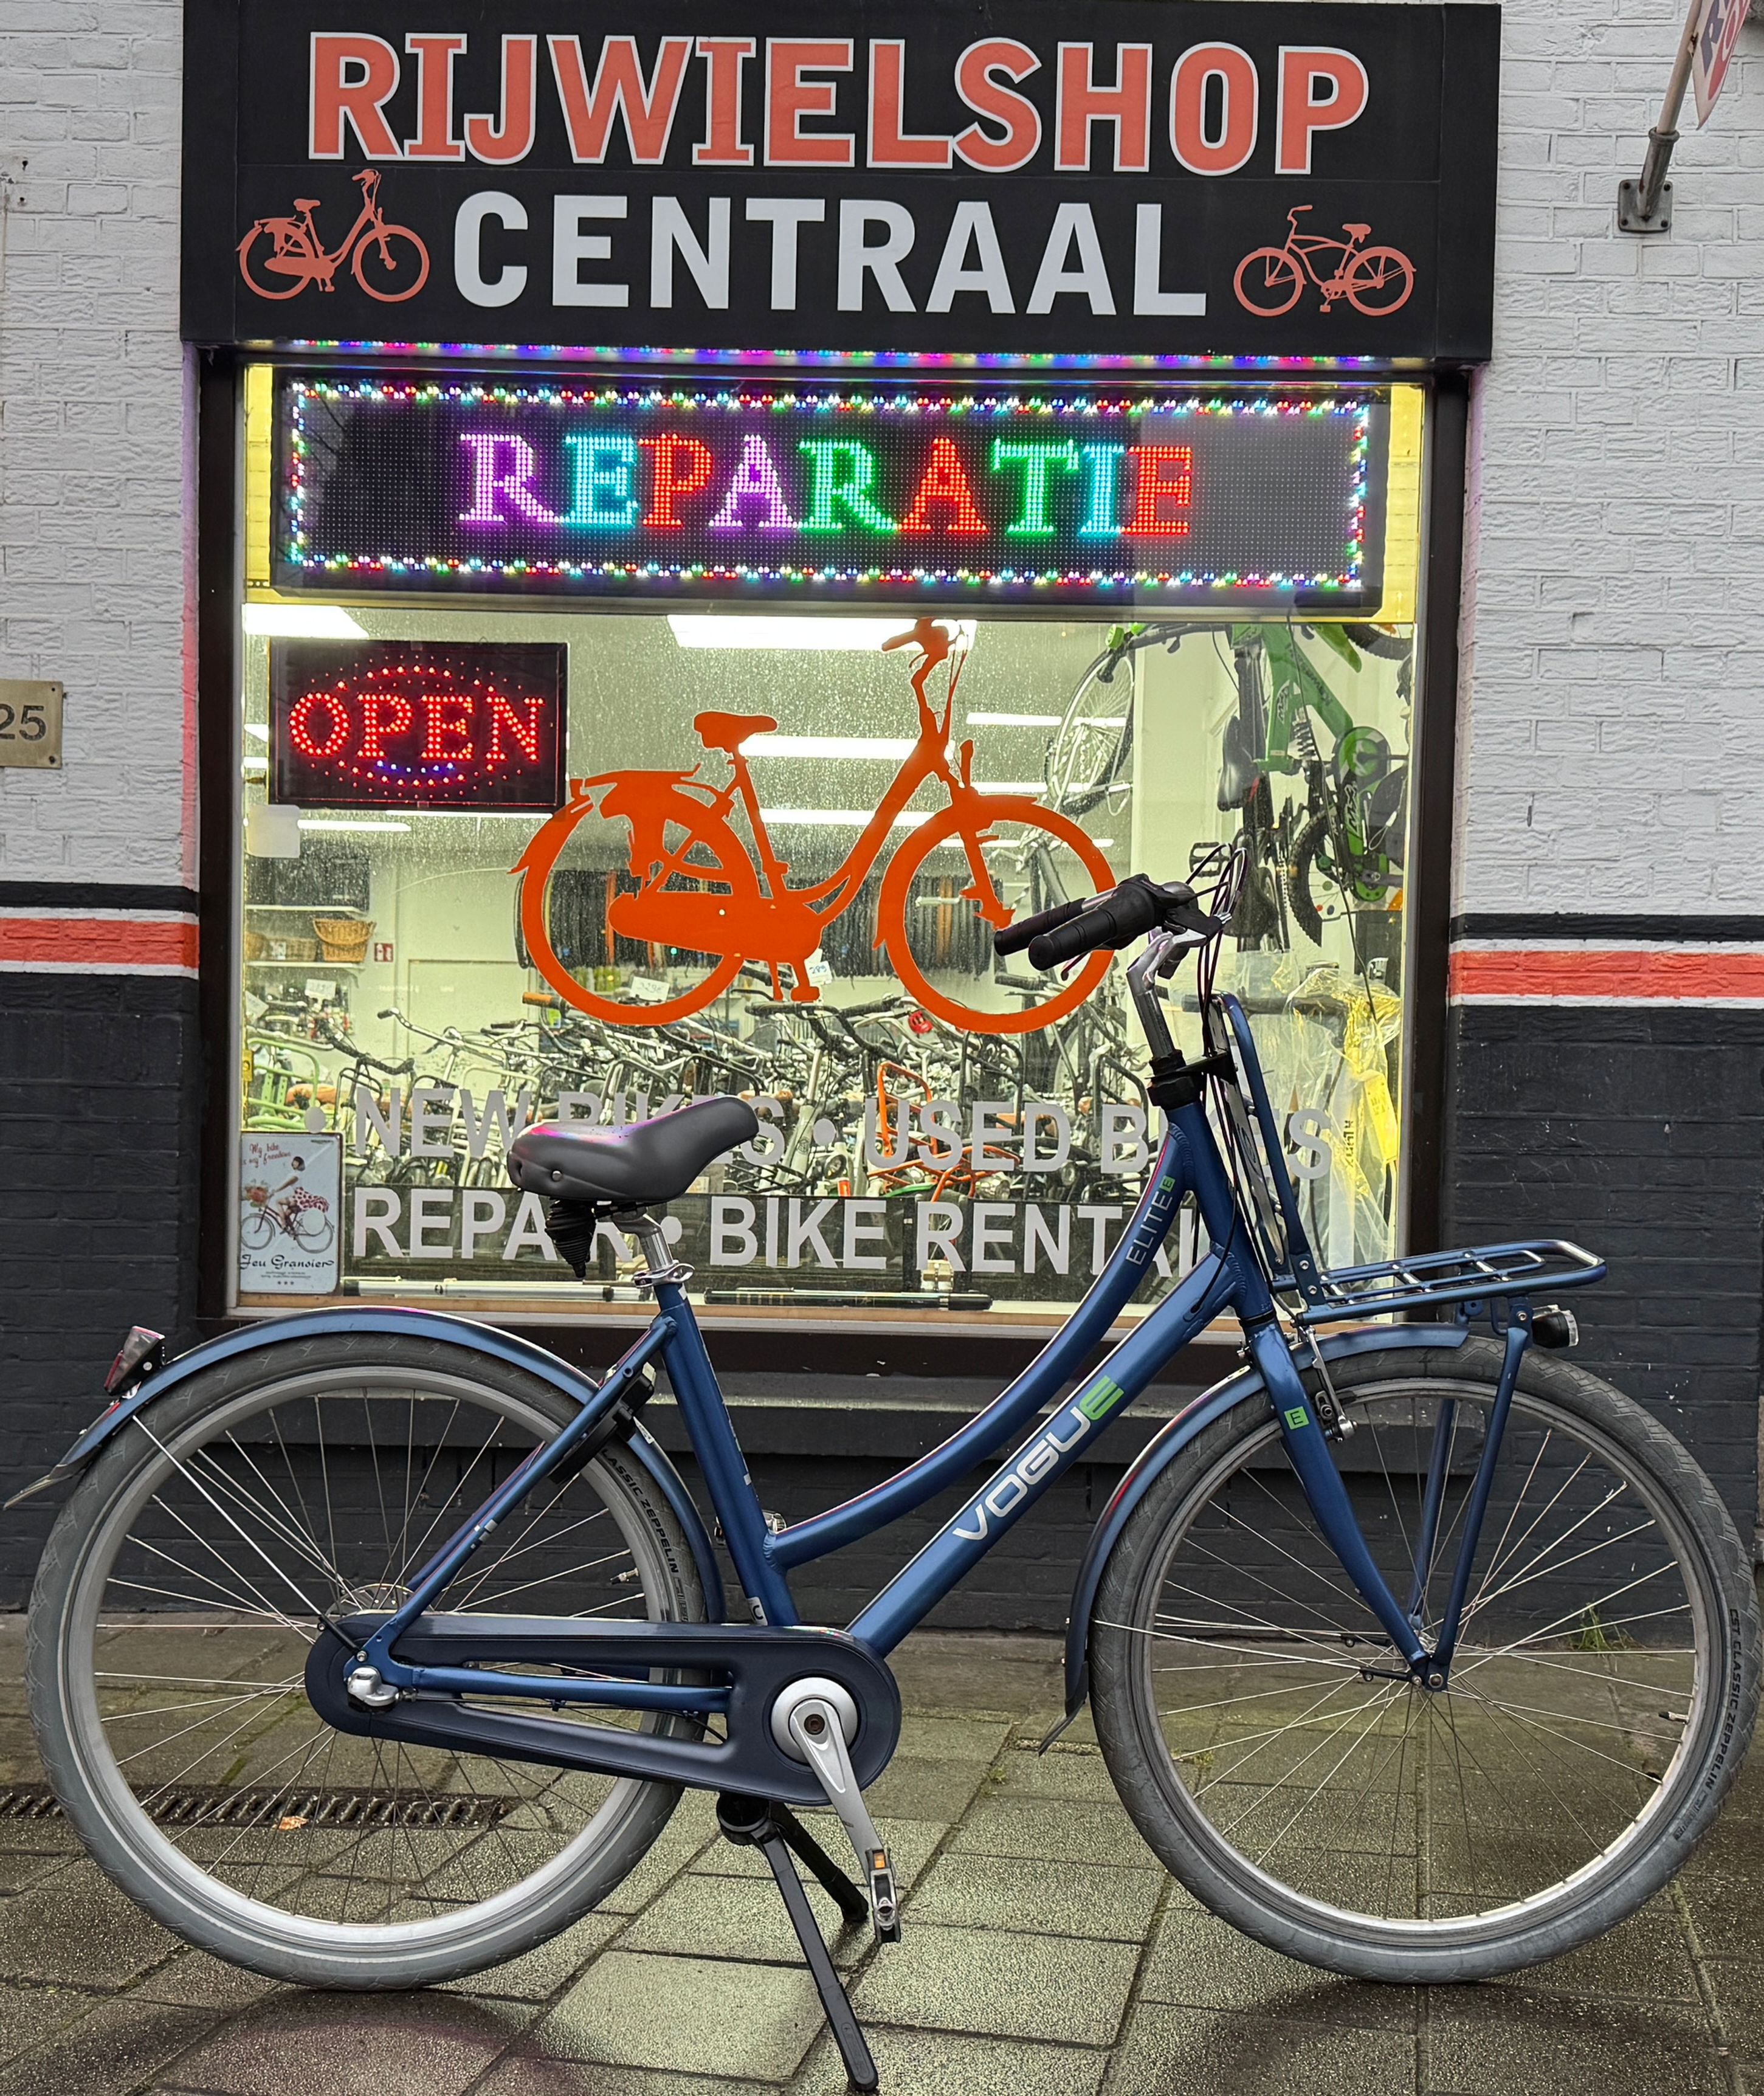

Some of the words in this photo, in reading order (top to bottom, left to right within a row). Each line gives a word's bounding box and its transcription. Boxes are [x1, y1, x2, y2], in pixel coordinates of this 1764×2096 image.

[308, 32, 1368, 176] RIJWIELSHOP
[454, 190, 1207, 316] CENTRAAL
[458, 433, 1193, 536] REPARATIE
[289, 691, 544, 762] OPEN
[355, 1087, 531, 1159] NEW
[865, 1098, 1071, 1173] USED
[710, 1196, 886, 1270] BIKE
[1126, 1190, 1173, 1266] ELITE
[1287, 1408, 1306, 1427] E
[953, 1375, 1125, 1540] VOGUE
[601, 1449, 643, 1497] LASSIC
[641, 1499, 679, 1574] ZEPPELIN
[1729, 1608, 1740, 1636] CST
[1731, 1639, 1742, 1711] CLASSIC
[1705, 1713, 1736, 1791] ZEPPELIN
